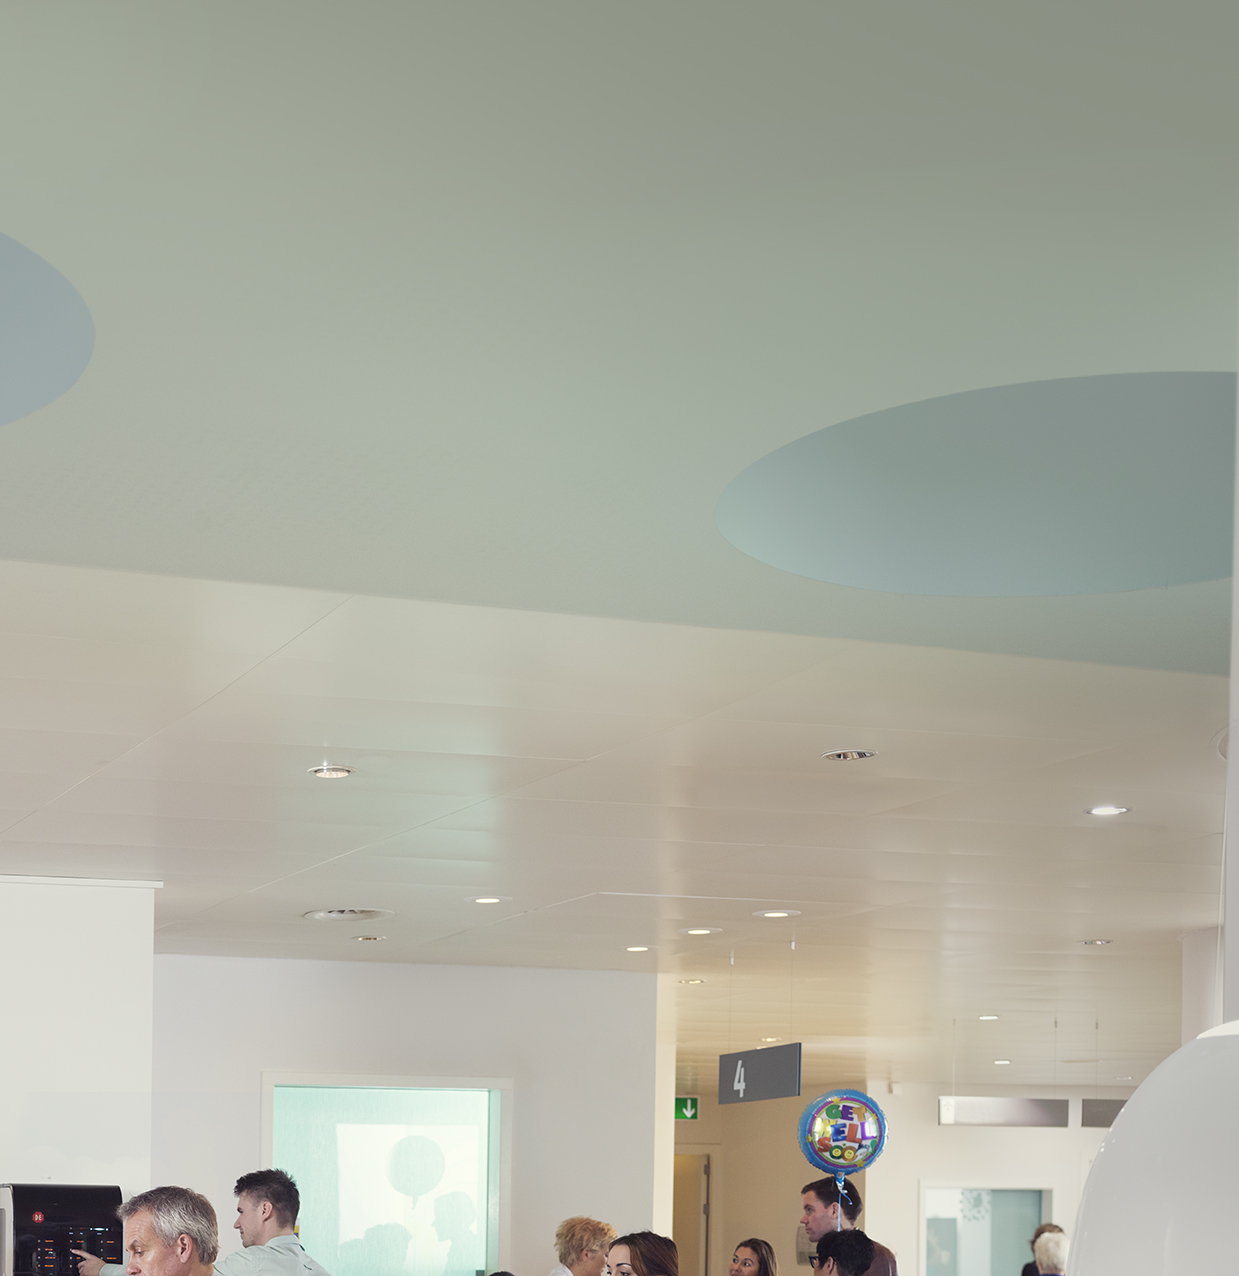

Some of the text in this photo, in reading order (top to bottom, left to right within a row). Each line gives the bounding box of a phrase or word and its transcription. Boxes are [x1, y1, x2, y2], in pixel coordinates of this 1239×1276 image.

[733, 1060, 746, 1098] 4
[825, 1104, 867, 1122] GET
[815, 1117, 877, 1144] WELL
